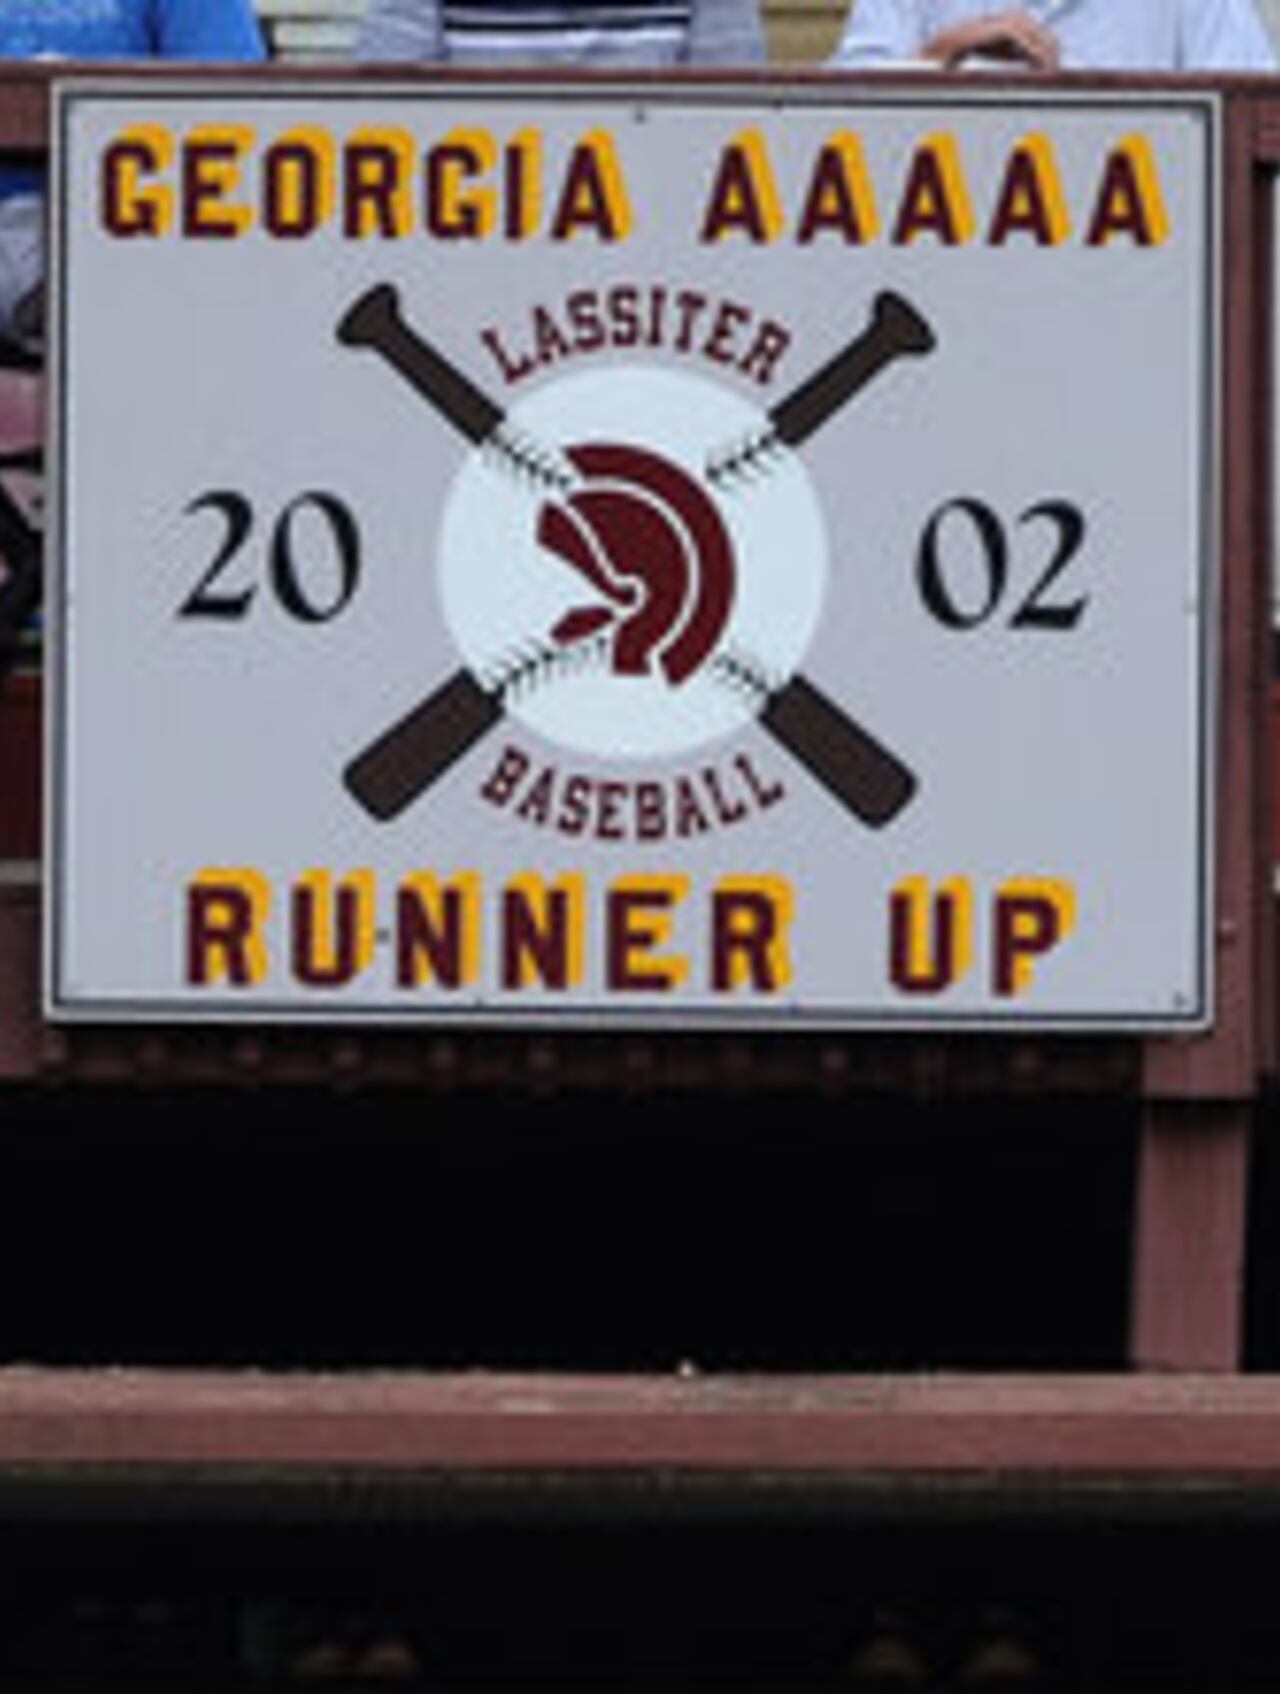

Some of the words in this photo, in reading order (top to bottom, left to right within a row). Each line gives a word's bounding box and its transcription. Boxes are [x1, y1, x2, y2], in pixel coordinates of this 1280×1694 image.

[98, 122, 635, 245] GEORGIA
[697, 126, 1171, 250] AAAAA
[480, 283, 792, 386] LASSITER
[175, 490, 362, 625] 20
[914, 496, 1089, 632] 02
[480, 745, 785, 840] BASEBALL
[182, 866, 795, 996] RUNNER
[886, 874, 1077, 999] UP
